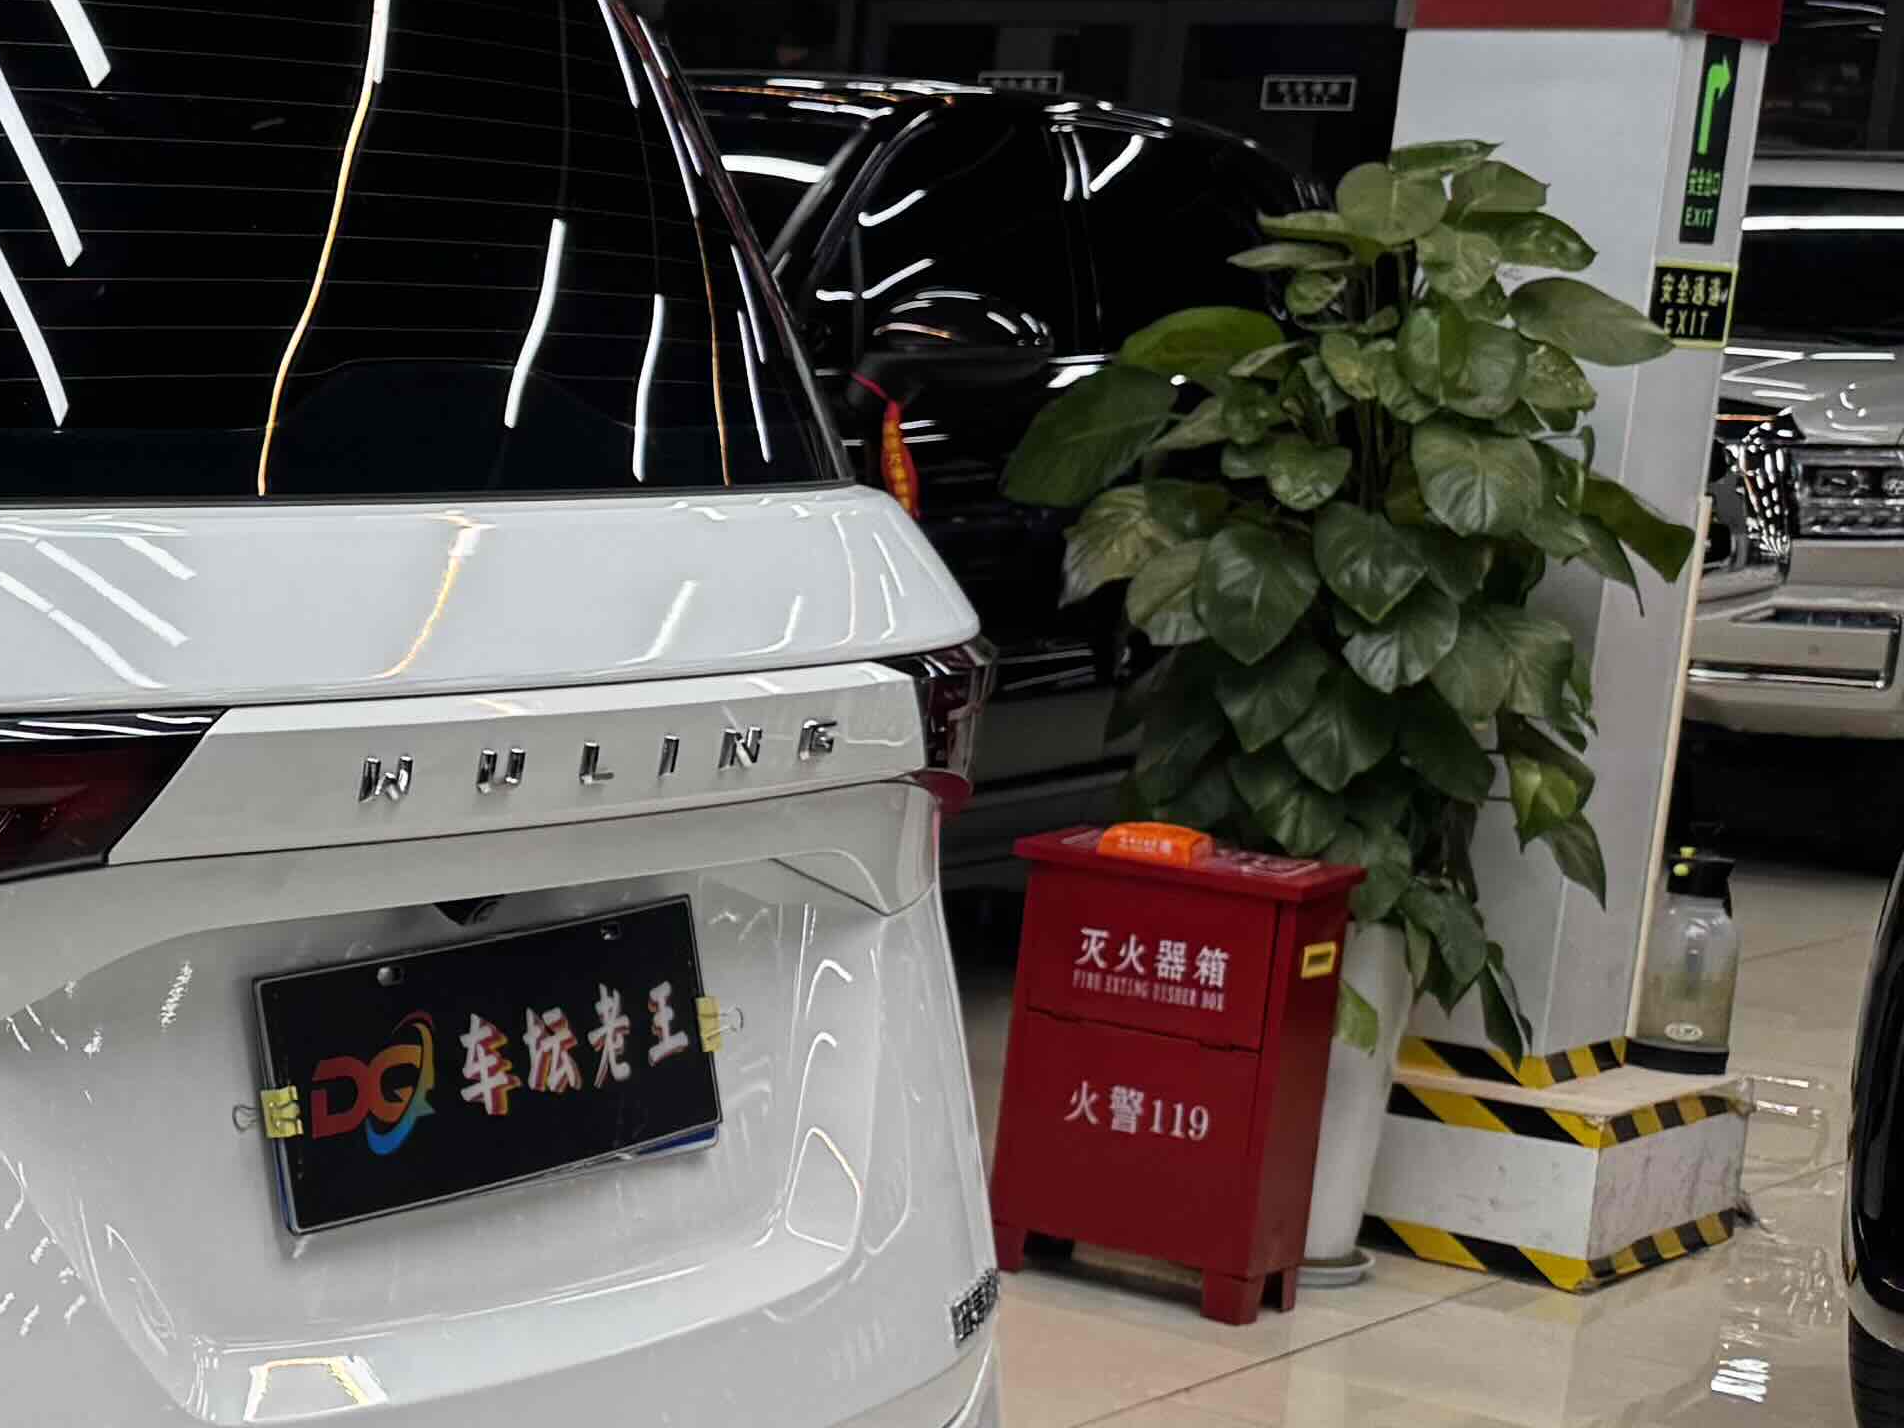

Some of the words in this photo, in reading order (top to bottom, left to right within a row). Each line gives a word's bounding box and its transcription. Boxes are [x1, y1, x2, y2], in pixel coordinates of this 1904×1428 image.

[1684, 207, 1715, 228] EXIT
[1663, 308, 1710, 337] EXIT
[358, 719, 838, 803] WULING
[1074, 926, 1230, 989] 灭火器箱
[459, 980, 691, 1117] 车坛老王
